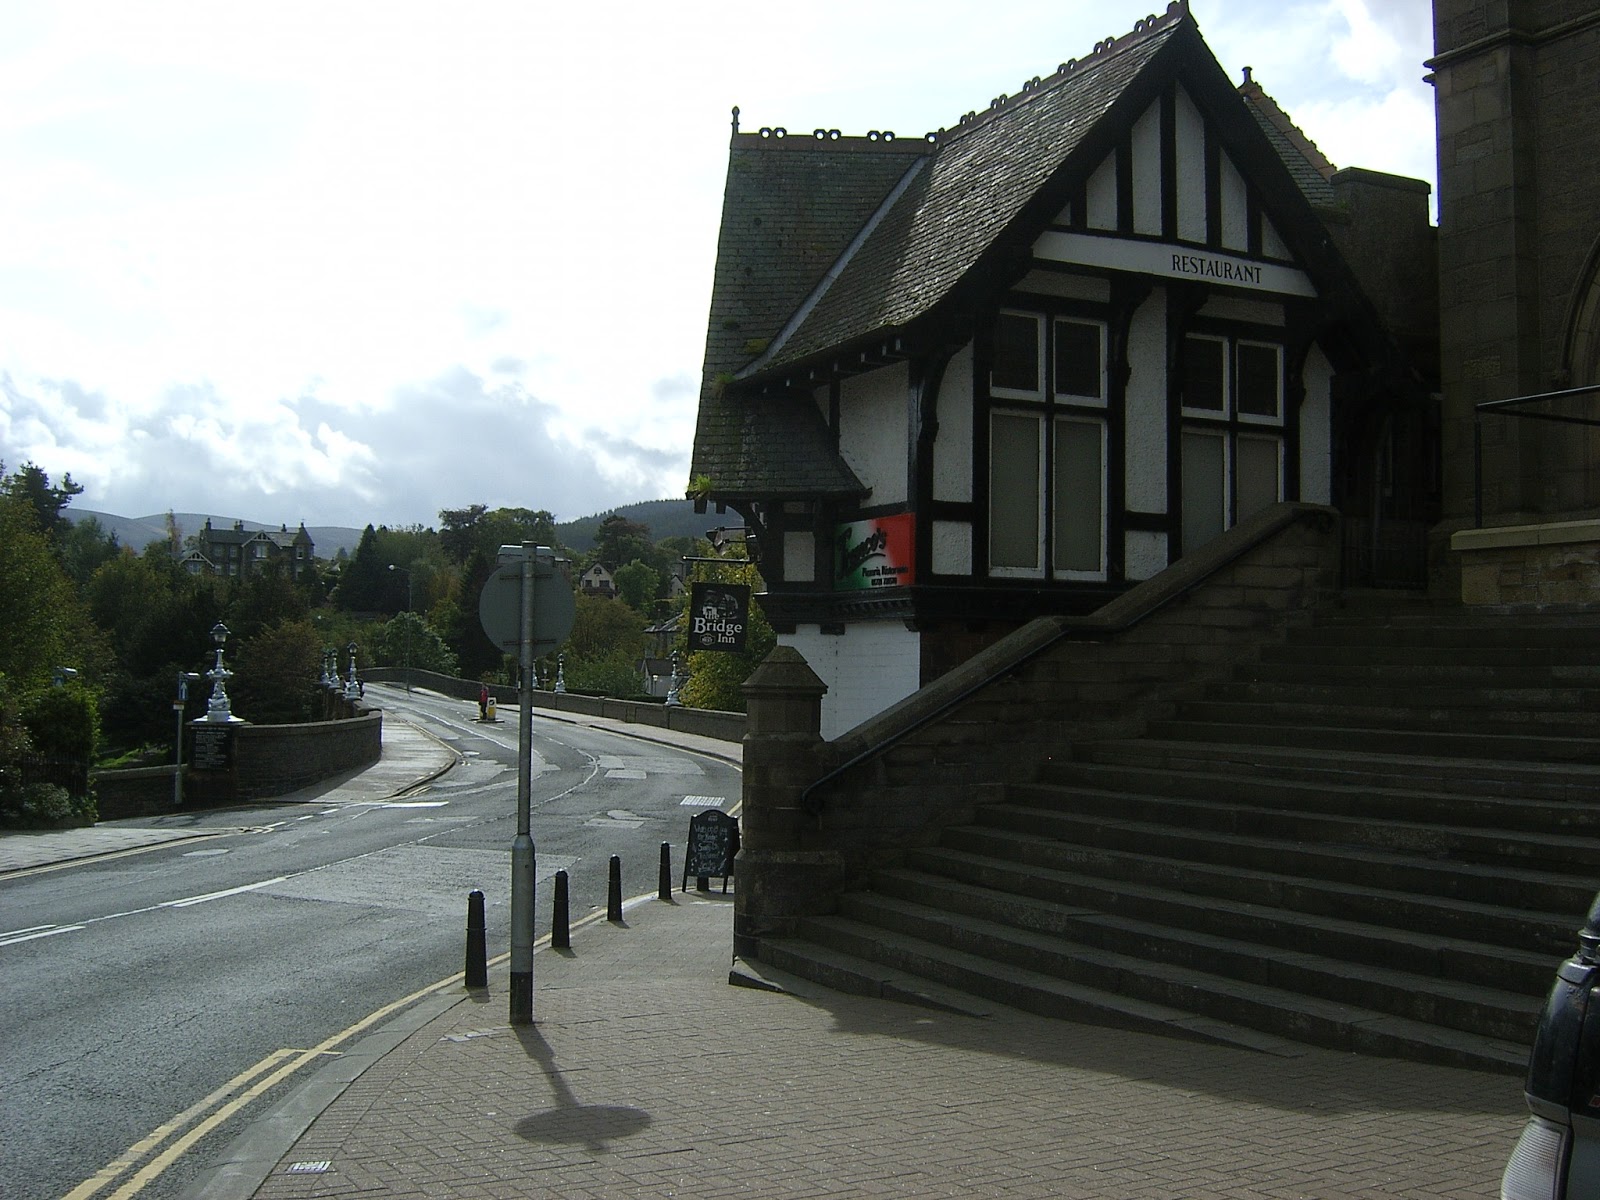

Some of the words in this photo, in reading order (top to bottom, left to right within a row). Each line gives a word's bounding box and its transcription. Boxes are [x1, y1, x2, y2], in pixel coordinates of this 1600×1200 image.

[1172, 254, 1262, 284] RESTAURANT
[693, 617, 743, 637] Bridge
[717, 633, 736, 644] Inn
